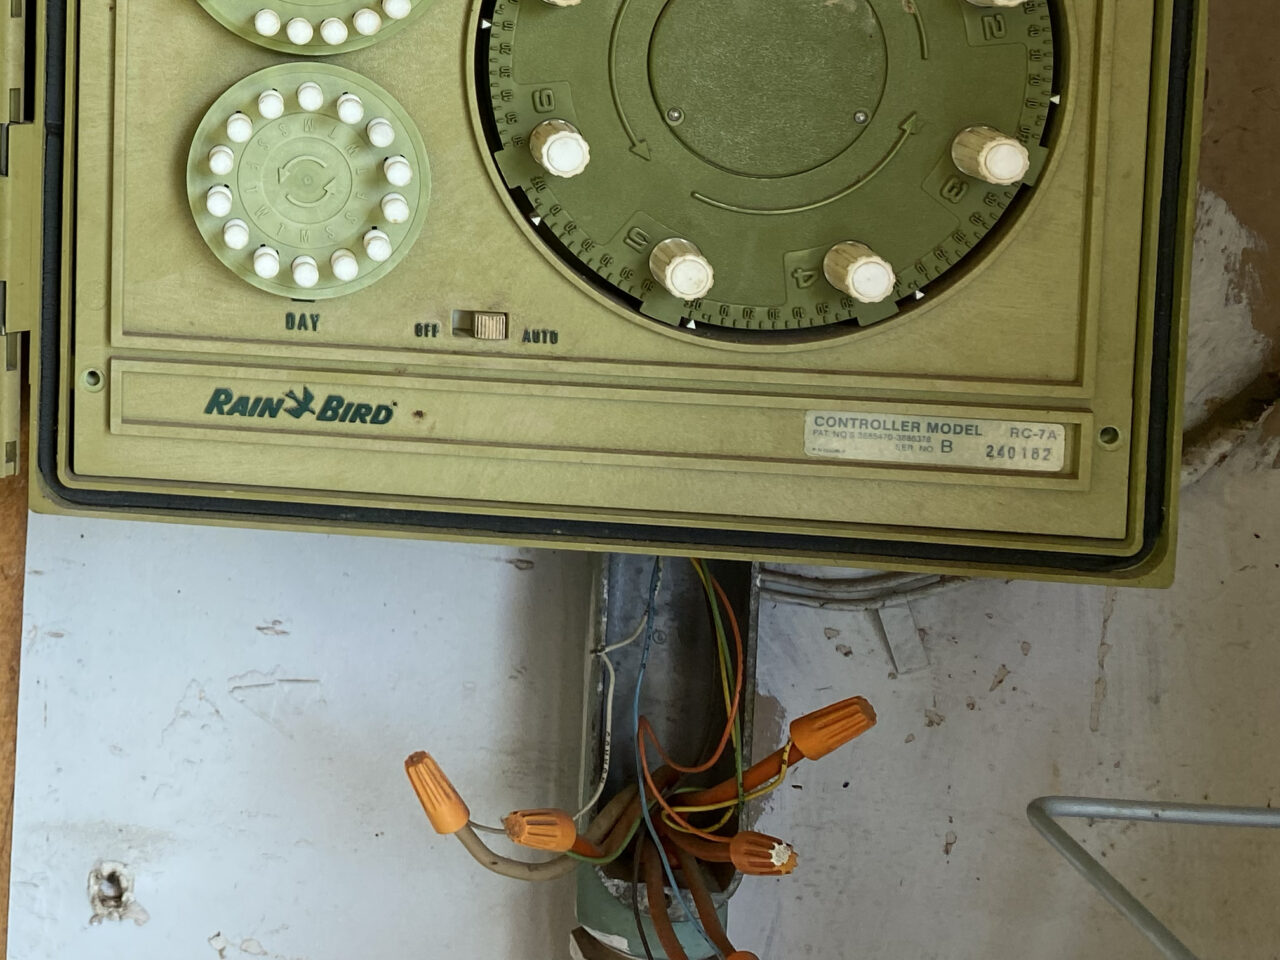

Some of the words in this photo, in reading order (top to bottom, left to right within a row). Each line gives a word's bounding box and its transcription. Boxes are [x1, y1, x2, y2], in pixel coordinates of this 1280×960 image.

[285, 313, 320, 332] DAY
[415, 323, 439, 338] OFF
[522, 329, 558, 345] AUTO
[204, 388, 286, 419] RAIN
[316, 396, 394, 425] BIRD
[814, 416, 921, 432] CONTROLLER
[927, 422, 983, 437] MODEL
[1010, 427, 1057, 440] RC-7A
[941, 440, 953, 453] B
